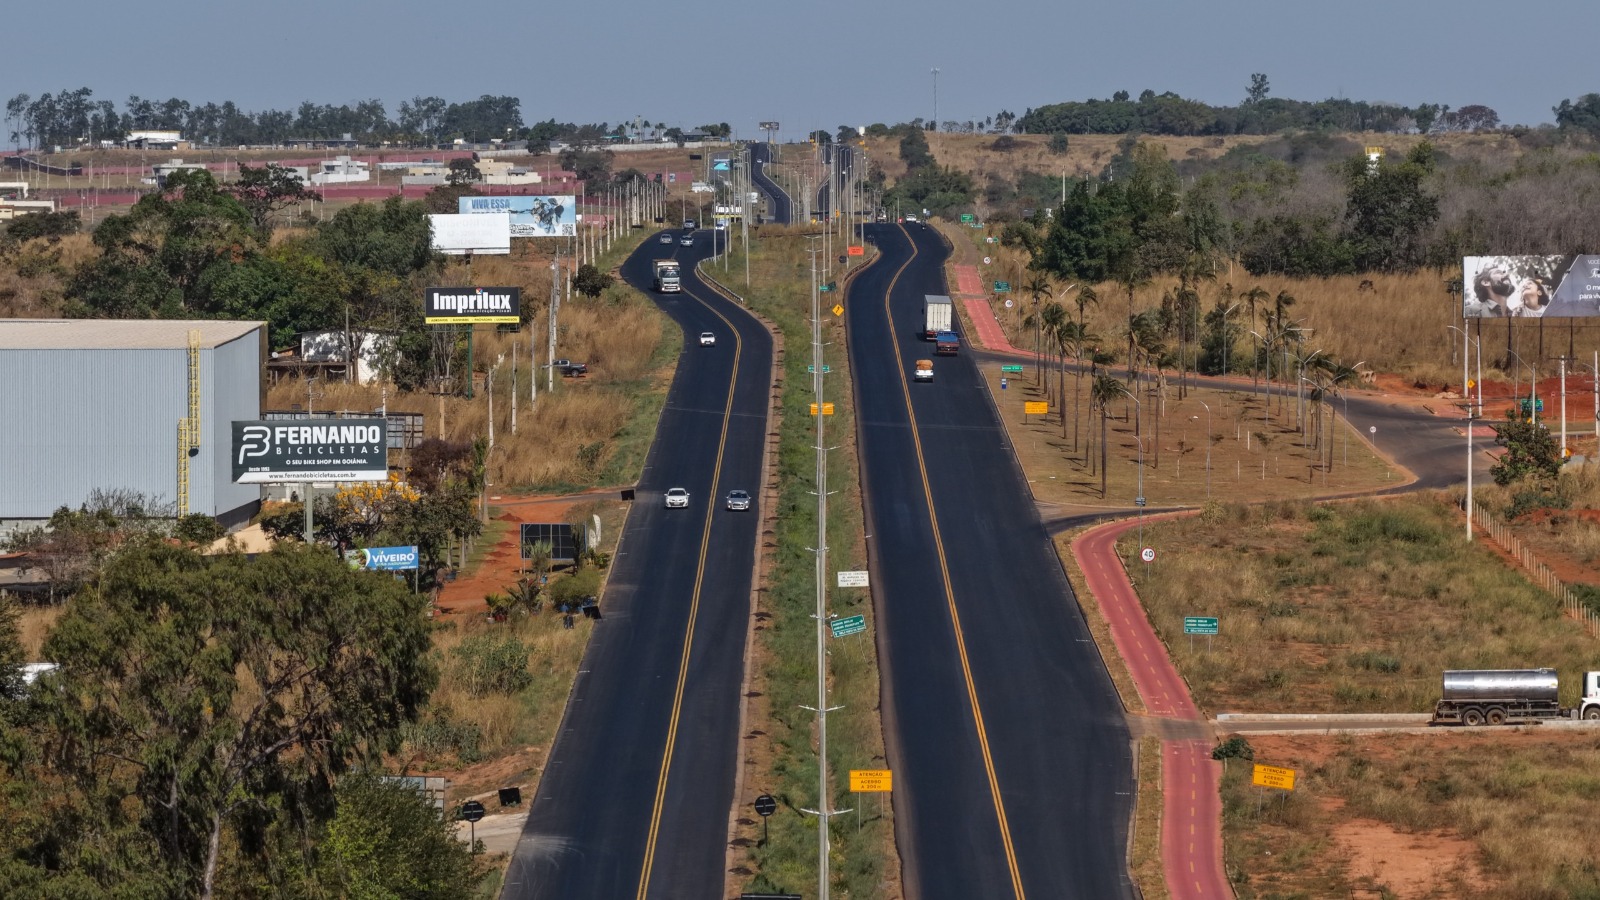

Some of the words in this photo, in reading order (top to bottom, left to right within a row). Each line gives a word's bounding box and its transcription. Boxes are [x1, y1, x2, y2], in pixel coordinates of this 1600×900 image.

[471, 198, 489, 210] VIVA
[490, 198, 511, 210] ESSA
[433, 291, 512, 313] Imprilux
[274, 425, 381, 445] FERNANDO
[275, 445, 380, 455] BICICLETAS
[268, 471, 357, 479] www.fernandobicicletas.com.br
[1144, 550, 1154, 558] 40
